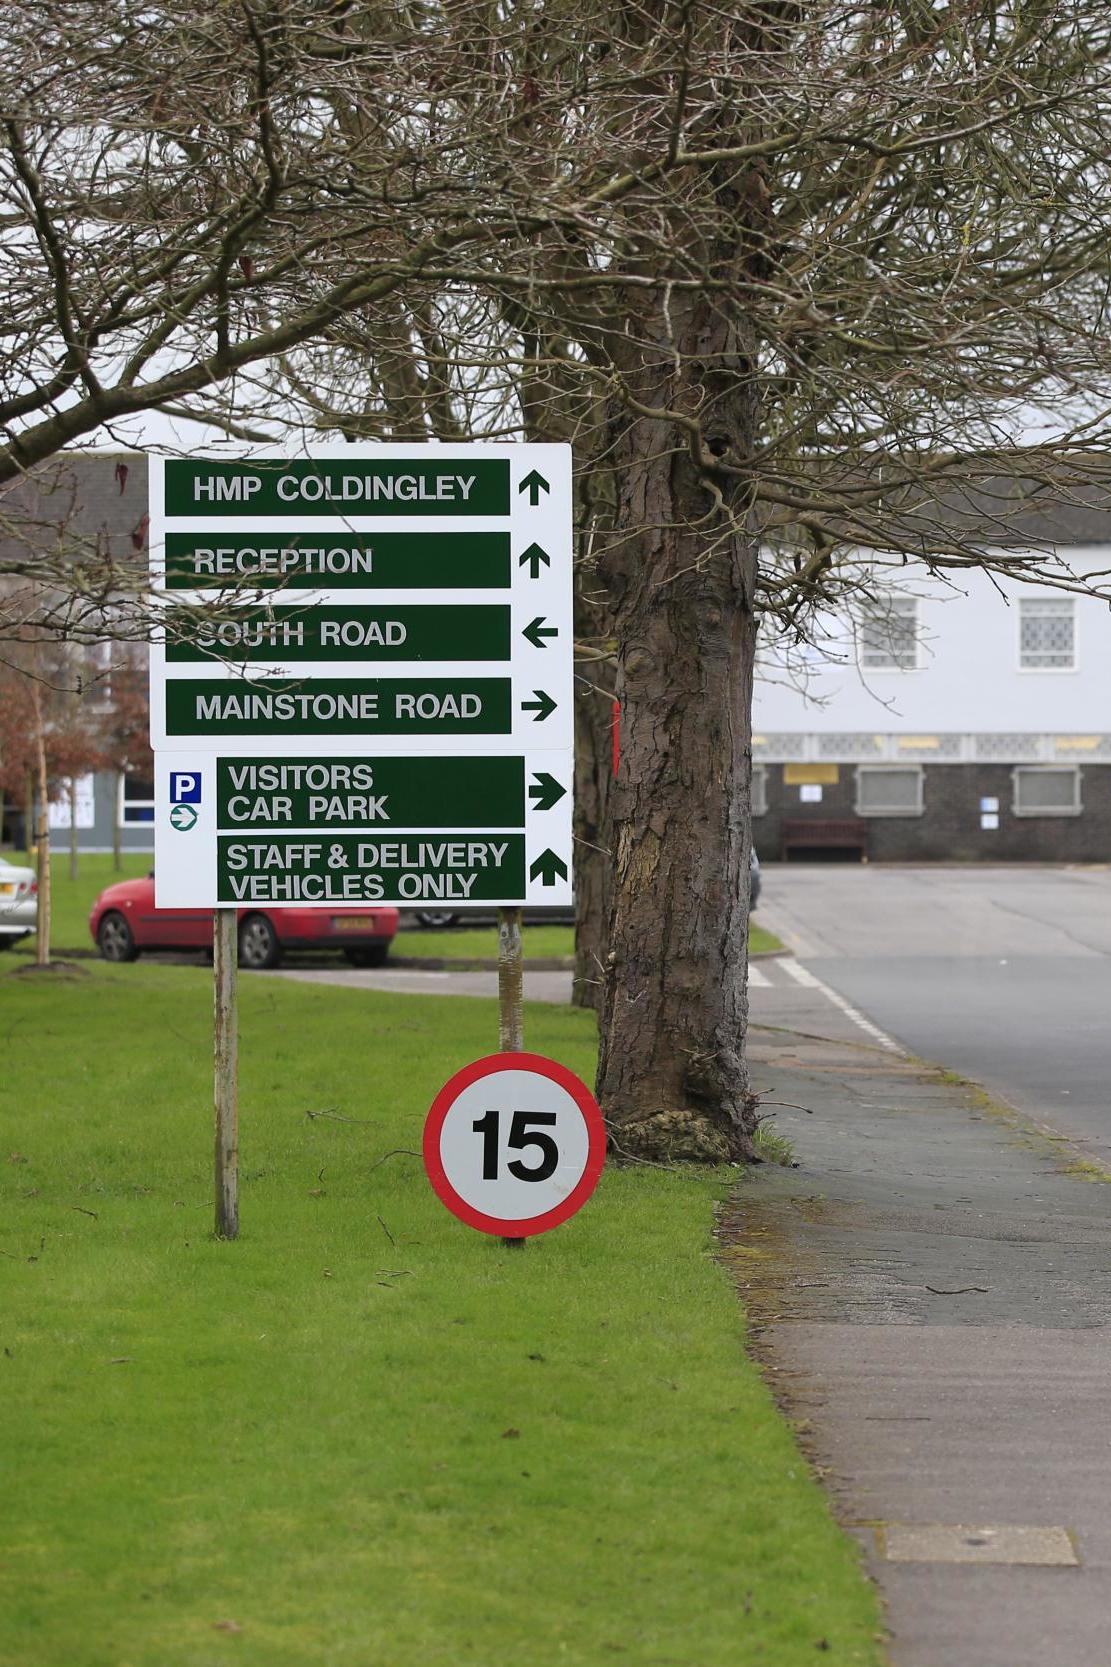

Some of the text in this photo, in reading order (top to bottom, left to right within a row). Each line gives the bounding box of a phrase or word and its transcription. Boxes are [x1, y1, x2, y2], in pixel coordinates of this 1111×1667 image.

[194, 475, 477, 502] HMP COLDINGLEY
[194, 548, 373, 575] RECEPTION
[320, 621, 407, 647] ROAD
[196, 694, 482, 720] MAINSTONE ROAD
[175, 775, 195, 801] P
[228, 764, 373, 791] VISITORS
[227, 795, 391, 821] CAR PARK
[226, 842, 509, 870] STAFF & DELIVERY
[229, 873, 478, 901] VEHICLES ONLY
[473, 1110, 560, 1183] 15
